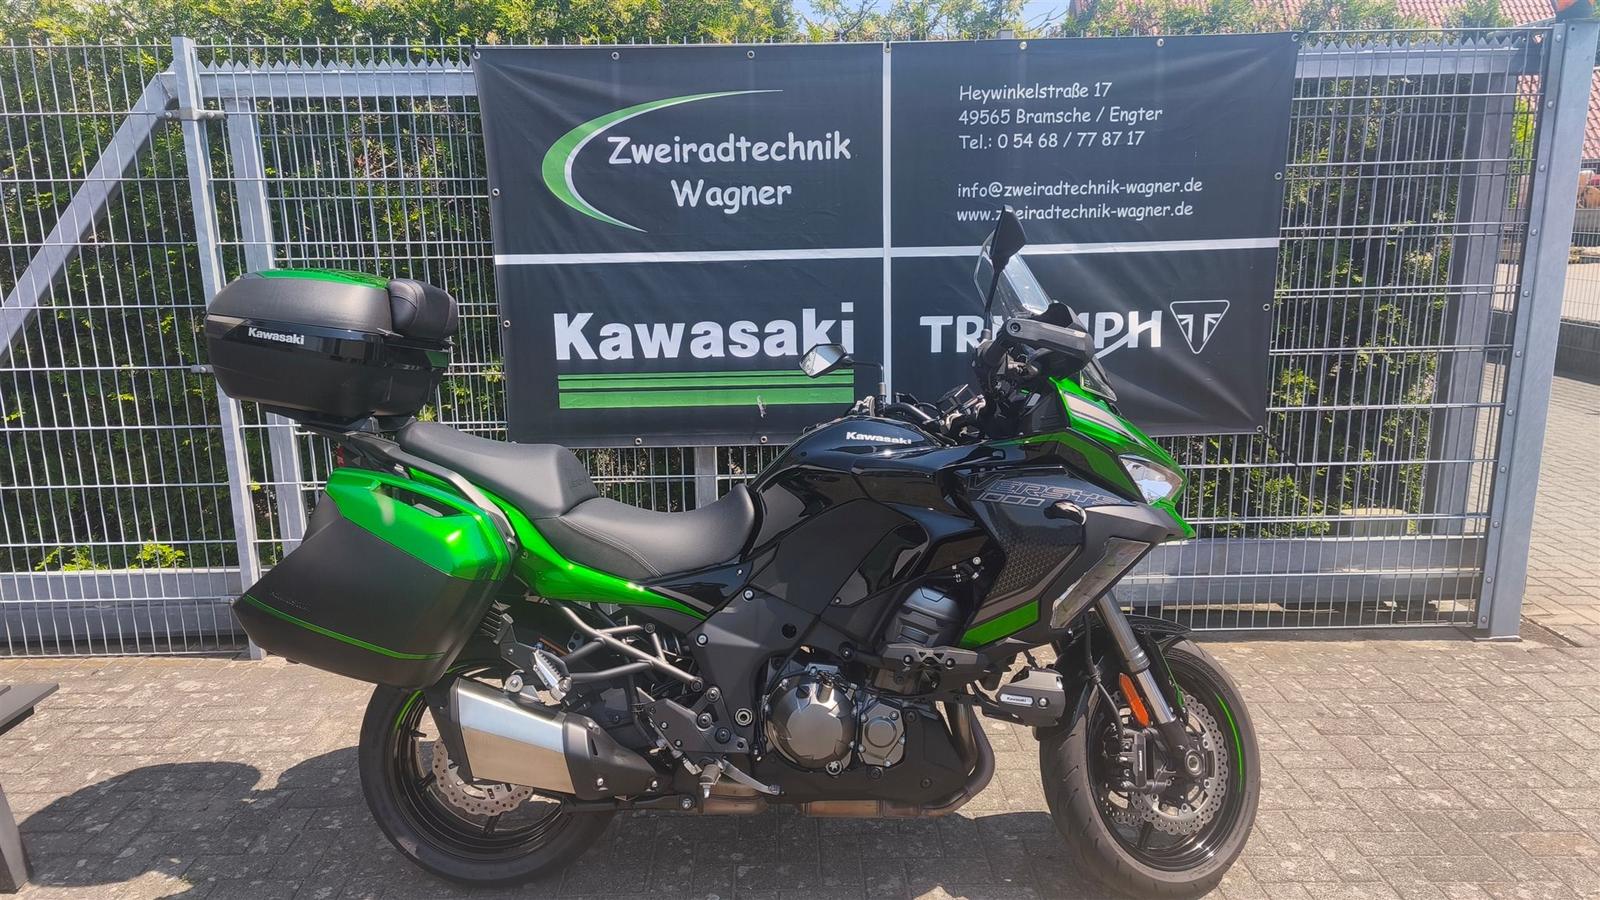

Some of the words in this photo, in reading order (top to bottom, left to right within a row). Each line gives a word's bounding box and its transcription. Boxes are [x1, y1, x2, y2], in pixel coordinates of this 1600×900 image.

[959, 82, 1089, 105] Heywinkelstraße
[1094, 82, 1112, 98] 17
[958, 109, 1011, 126] 49565
[1016, 107, 1091, 124] Bramsche
[1096, 106, 1105, 123] /
[1109, 106, 1163, 126] Engter
[607, 130, 851, 165] Zweiradtechnik
[958, 135, 992, 150] Tel.:
[997, 134, 1008, 149] 0
[1013, 133, 1033, 148] 54
[1038, 132, 1058, 148] 68
[1063, 131, 1072, 148] /
[1077, 131, 1097, 147] 77
[1101, 131, 1122, 146] 87
[1127, 130, 1145, 146] 17
[670, 178, 792, 214] Wagner
[957, 177, 1203, 198] info@zweiradtechnik-wagner.de
[957, 201, 1194, 222] www.zeiradtechnik-wagner.de
[248, 327, 305, 345] Kawasaki
[553, 302, 854, 360] Kawasaki
[846, 431, 912, 445] Kawasaki
